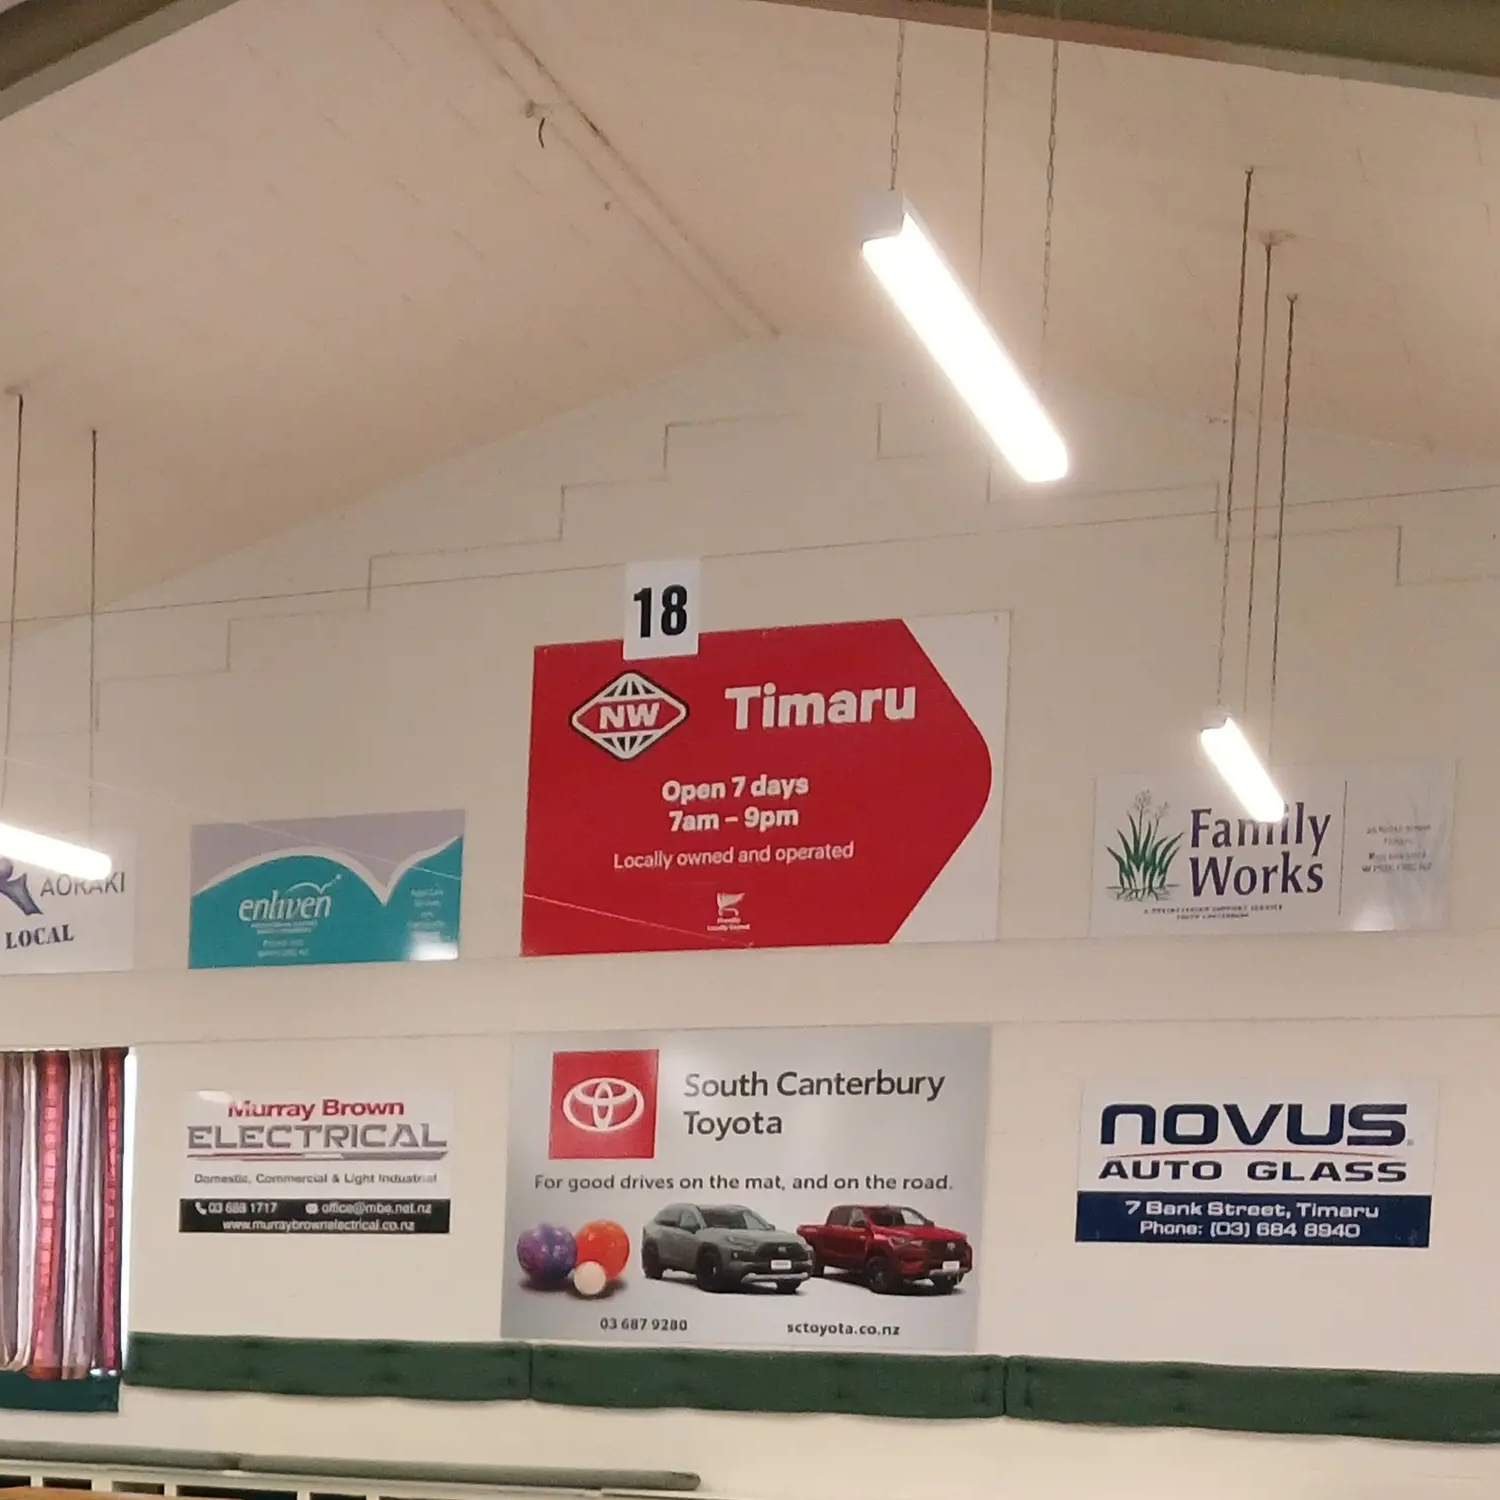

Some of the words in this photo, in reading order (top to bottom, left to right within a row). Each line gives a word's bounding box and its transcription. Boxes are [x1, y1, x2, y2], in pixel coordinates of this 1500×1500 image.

[633, 584, 688, 638] 18
[599, 702, 660, 730] NW
[725, 682, 916, 730] Timaru
[662, 779, 726, 805] Open
[731, 776, 746, 798] 7
[750, 774, 809, 800] days
[669, 810, 720, 832] 7am
[744, 806, 799, 832] 9pm
[1190, 802, 1331, 857] Family
[613, 850, 673, 870] Locally
[676, 846, 734, 866] owned
[738, 845, 770, 864] and
[775, 841, 854, 864] operated
[1189, 851, 1324, 897] Works
[239, 889, 332, 921] enliven
[4, 924, 74, 950] LOCAL
[683, 1071, 768, 1097] South
[776, 1069, 946, 1101] Canterbury
[228, 1099, 316, 1121] Murray
[322, 1099, 404, 1118] Brown
[187, 1122, 447, 1149] ELECTRICAL
[683, 1111, 783, 1141] Toyota
[1100, 1103, 1408, 1146] NOVUS
[256, 1173, 328, 1184] Commercial
[332, 1173, 340, 1184] &
[344, 1173, 375, 1186] Light
[534, 1175, 563, 1189] For
[568, 1175, 615, 1193] good
[620, 1174, 674, 1189] drives
[679, 1177, 703, 1189] on
[709, 1174, 740, 1189] the
[745, 1175, 786, 1191] mat,
[792, 1174, 828, 1189] and
[834, 1177, 859, 1189] on
[865, 1174, 897, 1189] the
[903, 1174, 953, 1190] road.
[1099, 1160, 1223, 1180] AUTO
[1247, 1161, 1407, 1183] GLASS
[249, 1202, 278, 1214] 1717
[1125, 1200, 1141, 1215] 7
[1146, 1201, 1202, 1216] Bank
[1208, 1201, 1292, 1219] Street,
[1296, 1202, 1379, 1218] Timaru
[1140, 1220, 1203, 1236] Phone:
[1210, 1221, 1250, 1238] (03)
[600, 1318, 617, 1330] 03
[621, 1318, 647, 1331] 687
[787, 1321, 900, 1337] sctoyota.co.nz
